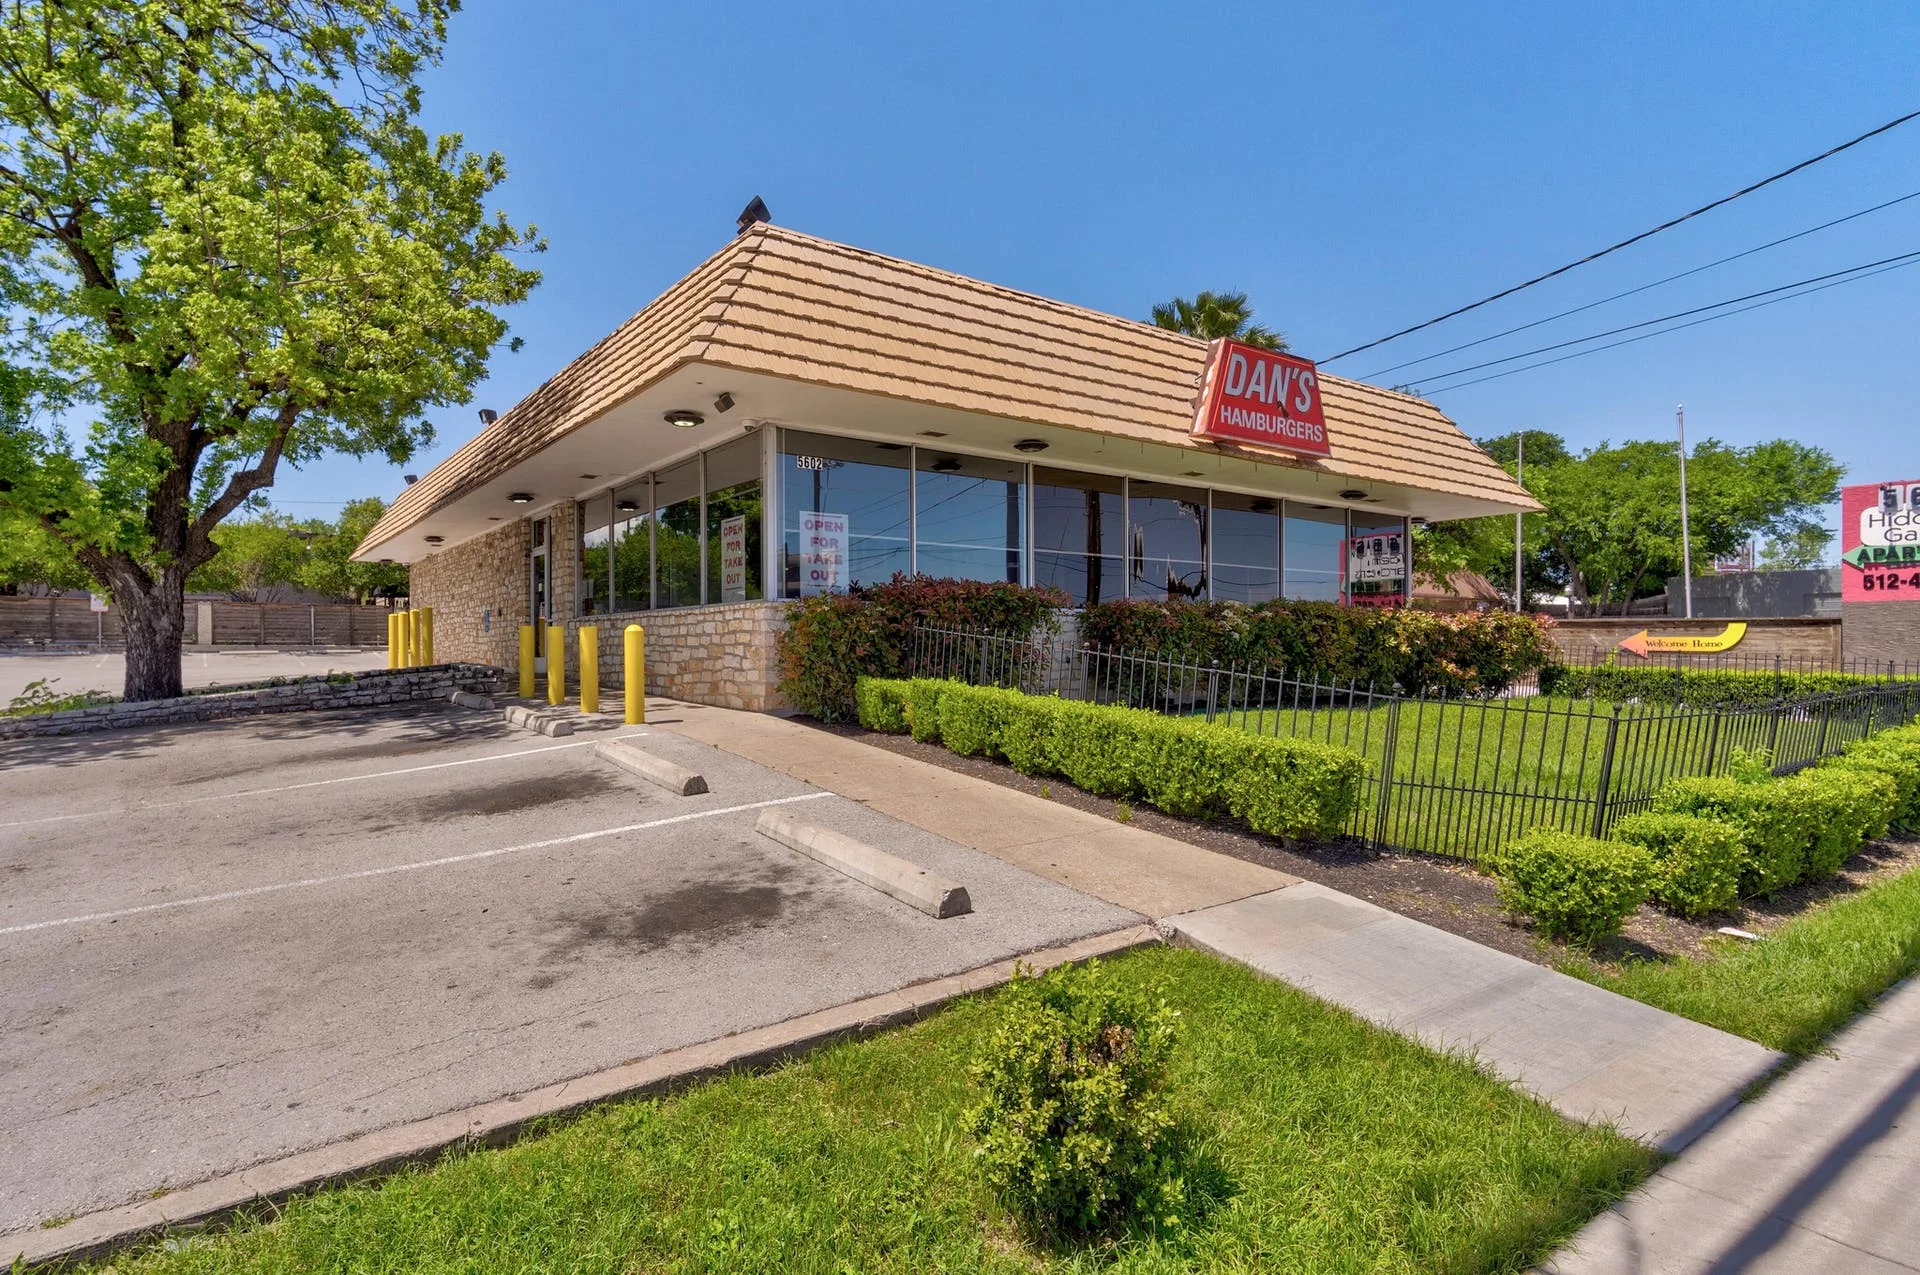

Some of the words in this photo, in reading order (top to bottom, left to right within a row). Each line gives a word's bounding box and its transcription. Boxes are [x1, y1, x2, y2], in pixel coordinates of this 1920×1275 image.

[1224, 353, 1315, 413] DAN'S
[1220, 405, 1323, 442] HAMBURGERS
[798, 456, 822, 470] 5602
[723, 524, 743, 537] OPEN
[803, 519, 844, 532] OPEN
[726, 540, 741, 552] FOR
[810, 536, 839, 548] FOR
[724, 556, 743, 569] TAKE
[807, 554, 844, 565] TAKE
[726, 573, 741, 585] OUT
[1645, 639, 1688, 648] Welcome
[1692, 640, 1723, 648] Home
